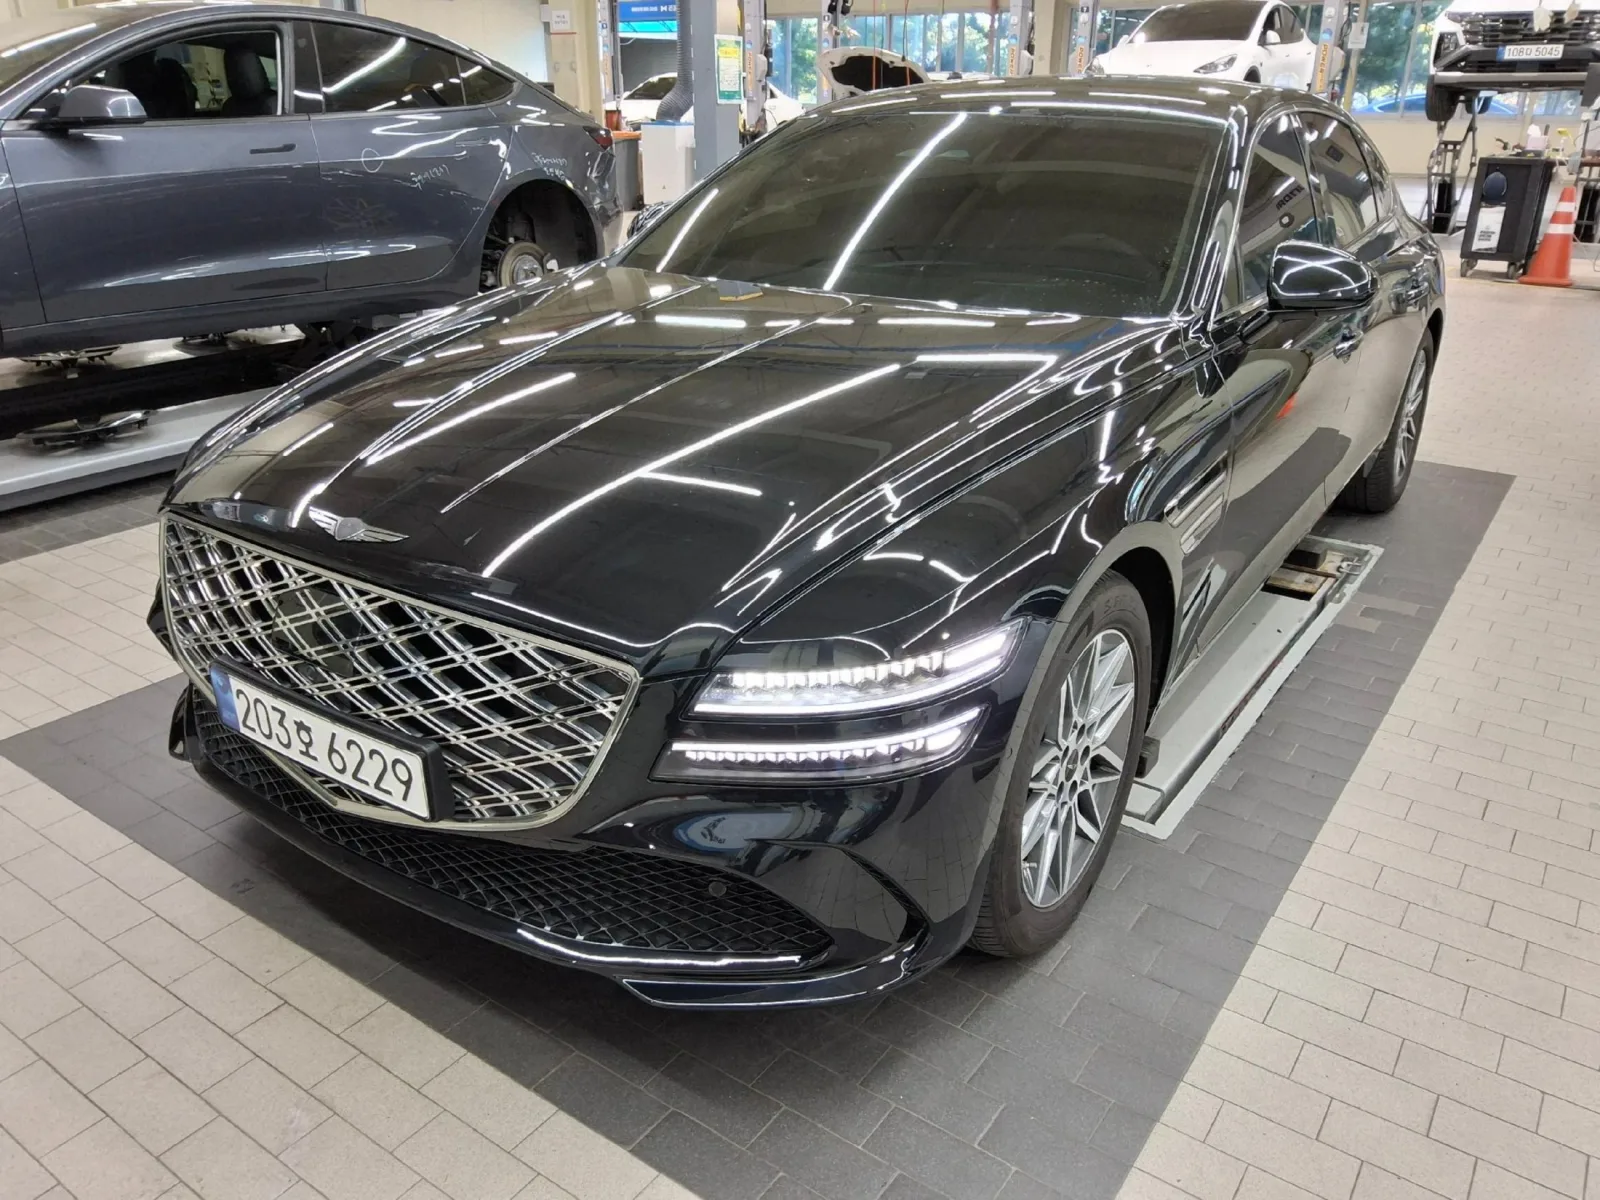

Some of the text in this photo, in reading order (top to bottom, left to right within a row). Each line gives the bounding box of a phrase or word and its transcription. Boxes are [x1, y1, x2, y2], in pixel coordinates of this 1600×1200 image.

[1534, 46, 1561, 57] 5045
[236, 688, 413, 802] 203호 6229
